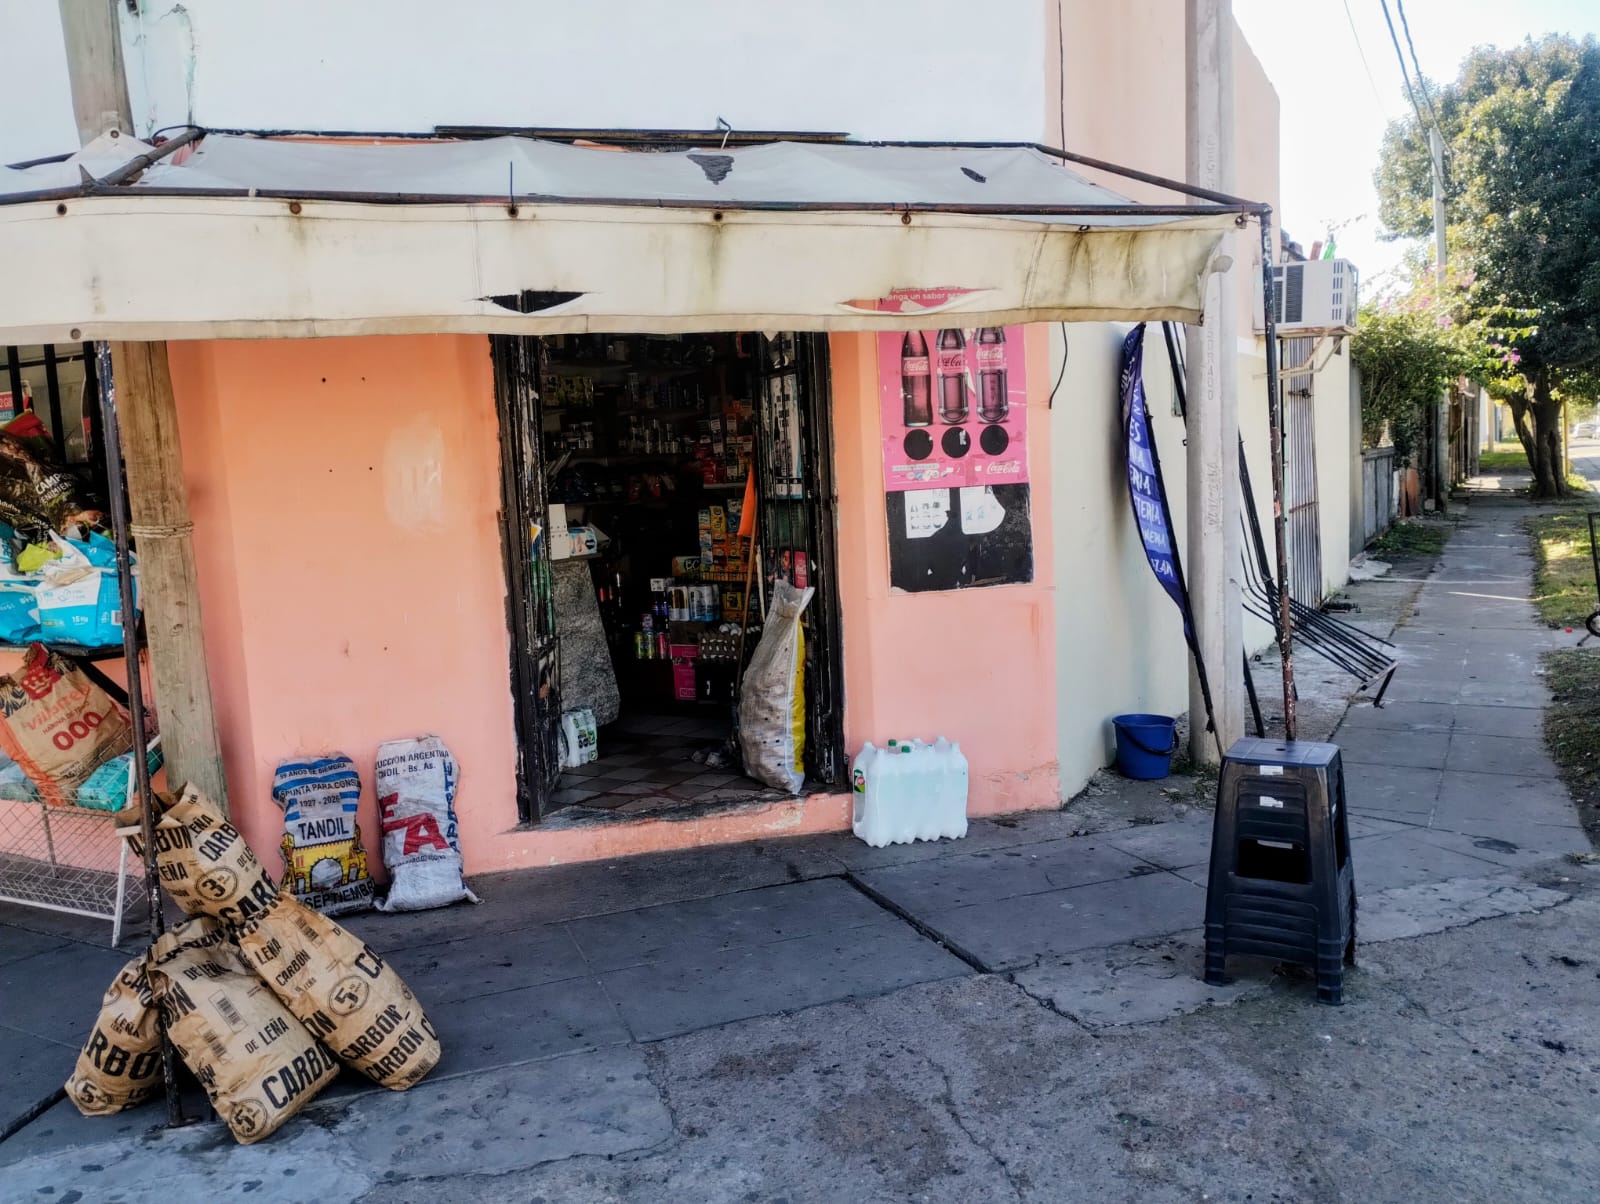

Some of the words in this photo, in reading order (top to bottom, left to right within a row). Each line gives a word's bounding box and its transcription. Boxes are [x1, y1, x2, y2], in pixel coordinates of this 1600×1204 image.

[52, 711, 103, 750] 000
[190, 814, 214, 838] EÑA
[298, 817, 350, 841] TANDIL
[159, 861, 189, 882] EÑA
[202, 877, 226, 898] 3
[254, 937, 282, 965] LEÑA
[275, 948, 312, 987] CARBÓN
[334, 987, 360, 1010] 5
[245, 1039, 259, 1054] DE
[258, 1015, 290, 1046] LEÑA
